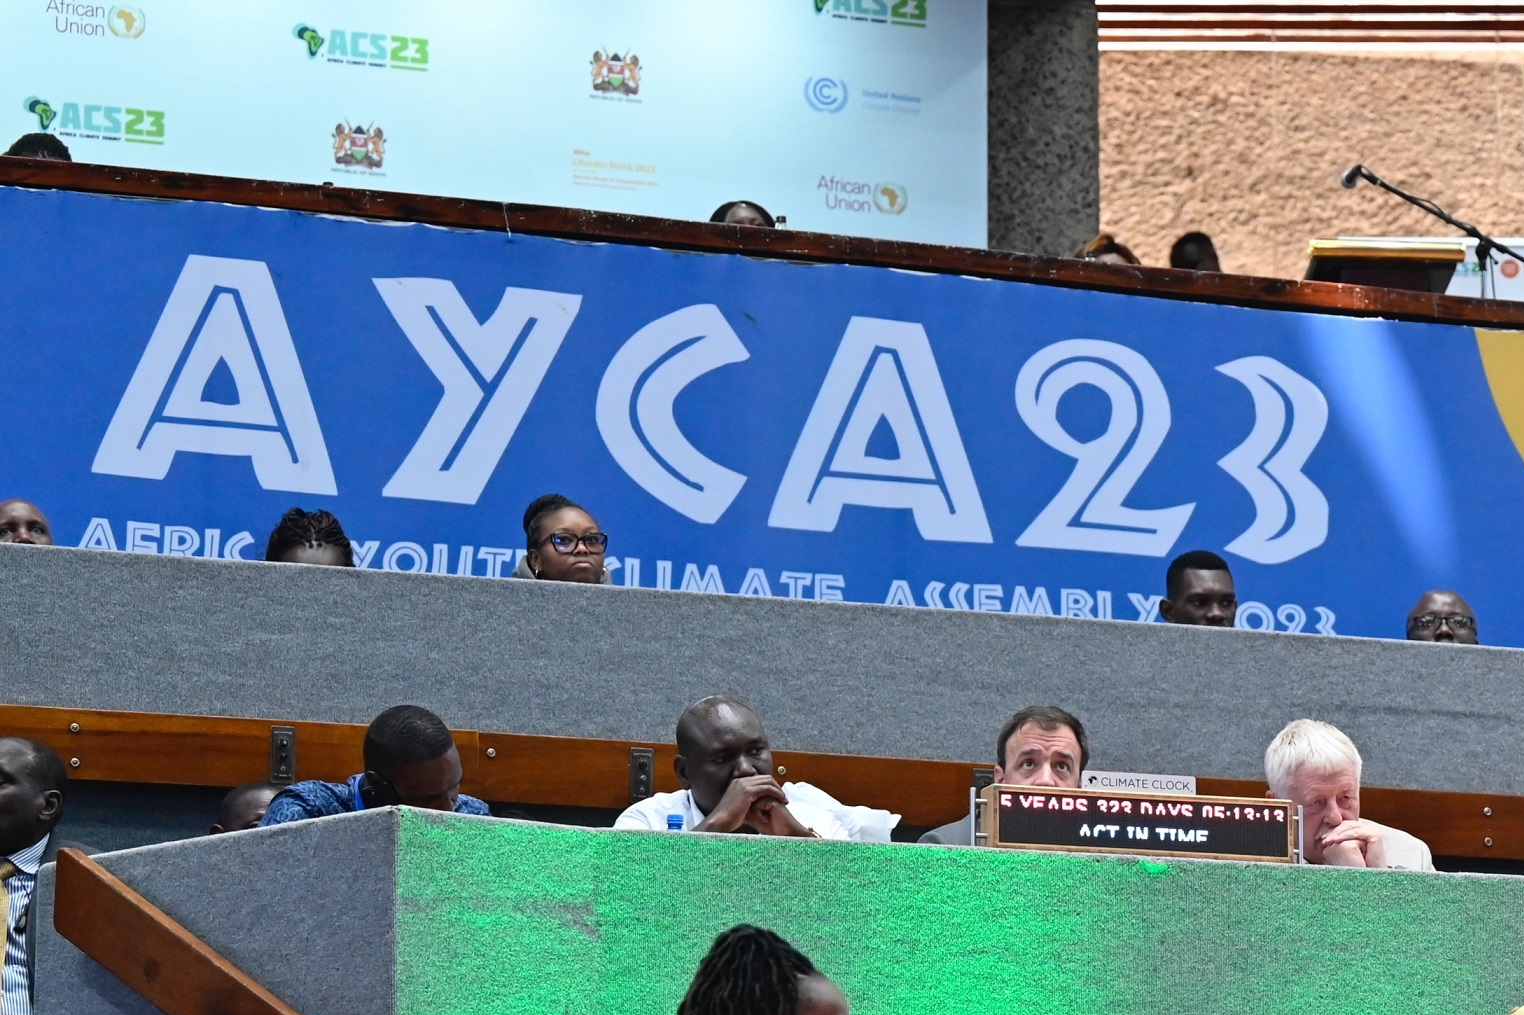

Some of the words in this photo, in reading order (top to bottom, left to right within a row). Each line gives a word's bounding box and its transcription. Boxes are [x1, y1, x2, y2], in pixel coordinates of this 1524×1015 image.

[45, 0, 106, 18] African
[55, 16, 105, 37] Union
[327, 29, 429, 65] ACS23
[59, 102, 165, 138] ACS23
[817, 174, 872, 195] African
[825, 193, 872, 213] Union
[78, 516, 256, 561] AFRIC
[350, 538, 527, 579] YOUT
[1235, 600, 1348, 636] 023
[1100, 776, 1149, 789] CLIMATE
[1151, 779, 1190, 791] CLOCK
[1126, 825, 1150, 840] IN
[1155, 827, 1210, 843] TIME
